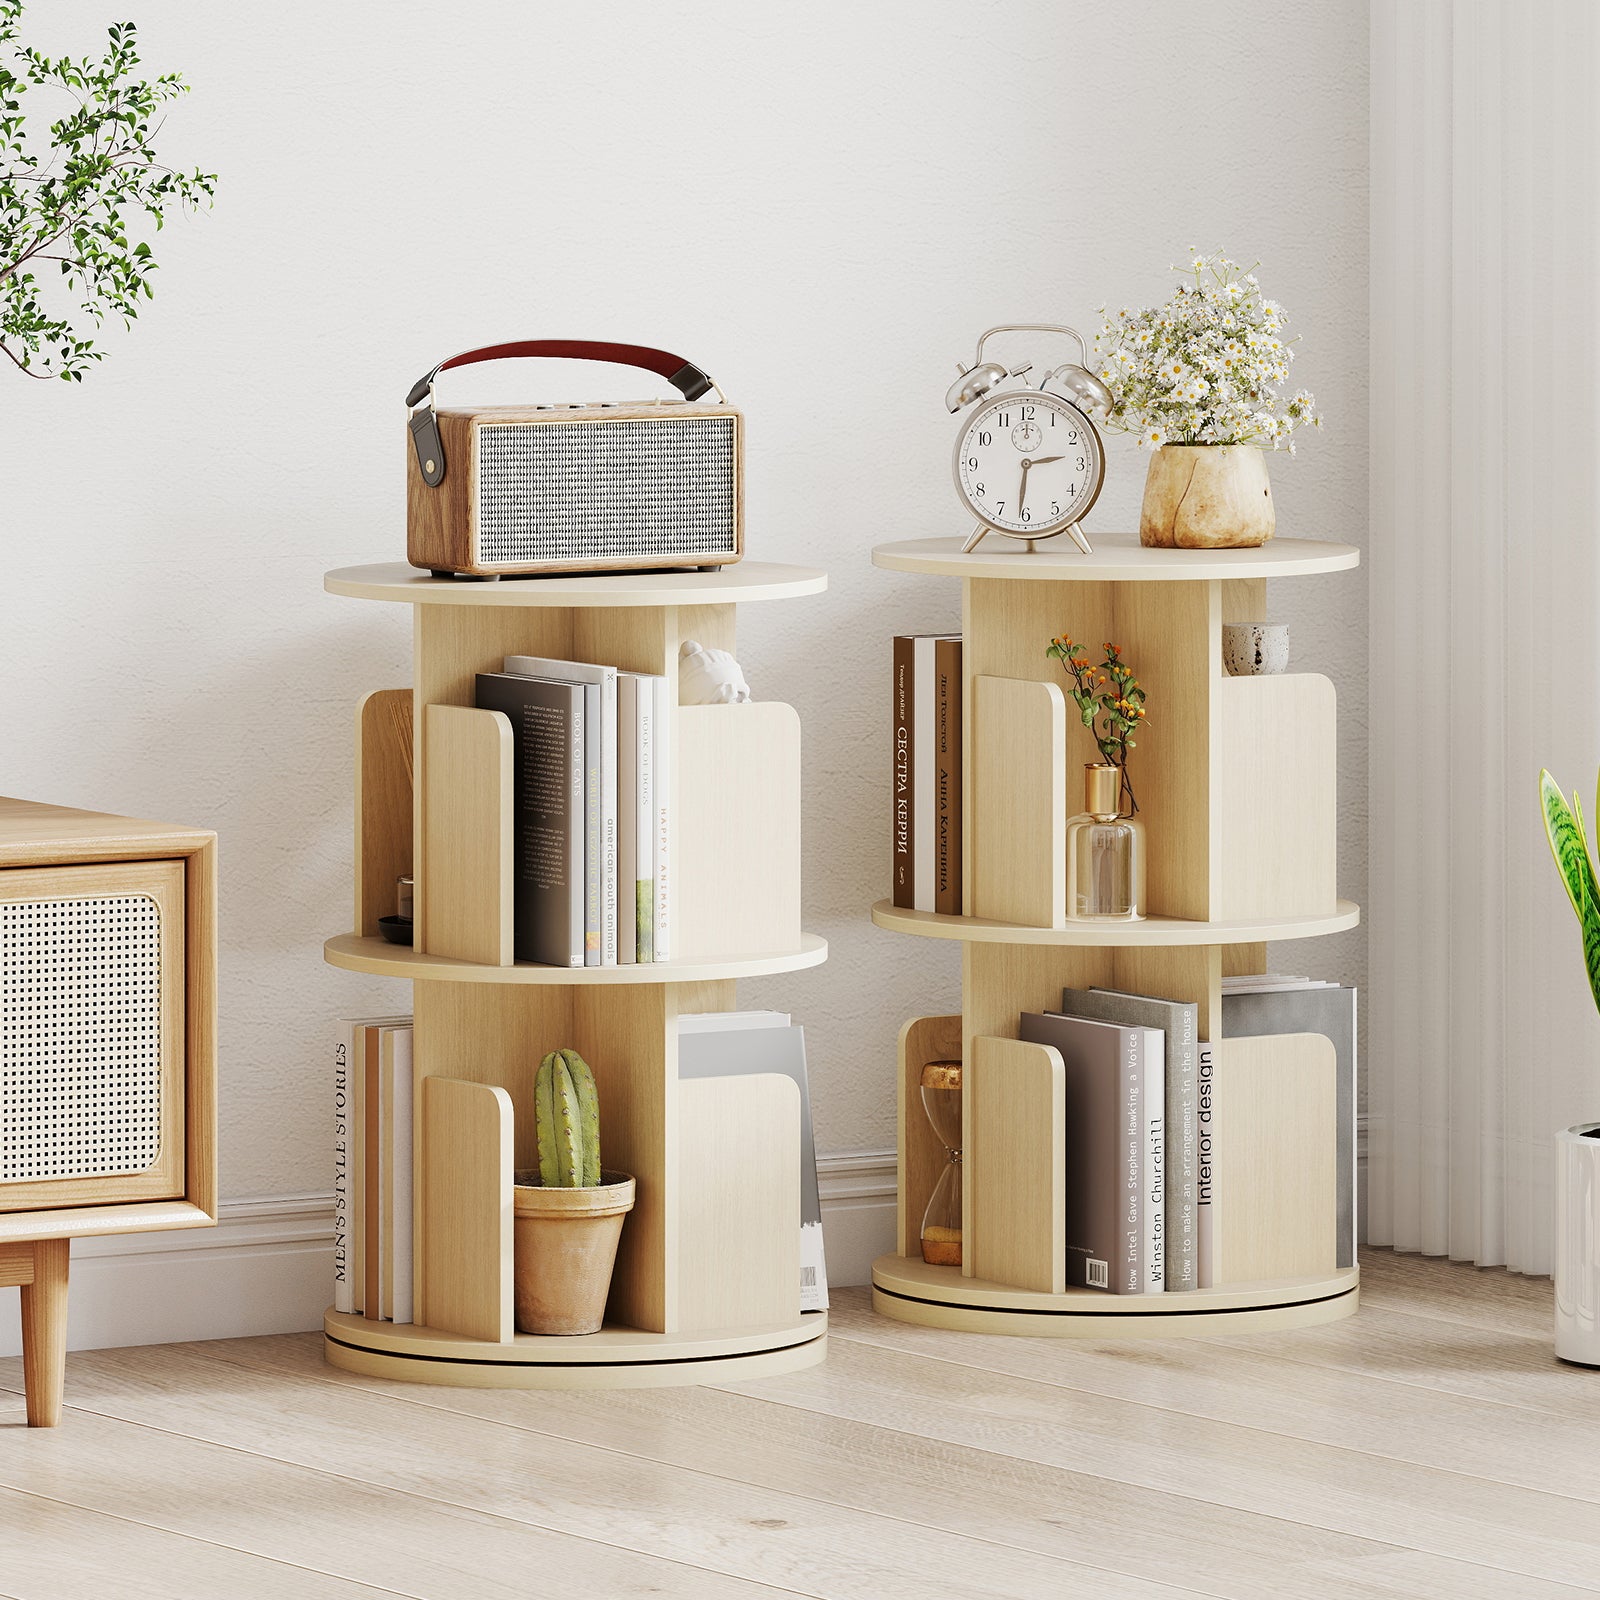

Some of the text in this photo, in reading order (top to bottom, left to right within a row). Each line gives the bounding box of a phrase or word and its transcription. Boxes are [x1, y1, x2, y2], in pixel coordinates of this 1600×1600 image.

[998, 413, 1009, 427] 11
[1021, 406, 1035, 420] 12
[1050, 413, 1056, 427] 1
[979, 432, 992, 446] 10
[1068, 431, 1077, 446] 2
[968, 457, 978, 472] 9
[1076, 457, 1085, 471] 3
[976, 482, 985, 497] 8
[1066, 483, 1076, 497] 4
[996, 501, 1005, 516] 7
[1021, 507, 1031, 522] 6
[1050, 501, 1060, 515] 5
[573, 712, 581, 797] BOOK OF CATS
[642, 753, 649, 769] OF
[589, 767, 597, 808] WORLD
[897, 727, 908, 854] СЕСТРА КЕРРИ
[589, 811, 597, 826] OF
[607, 818, 615, 960] american south animals
[589, 882, 597, 924] PARROT
[1127, 1033, 1137, 1068] Voice
[335, 1042, 346, 1136] STORIES
[1127, 1087, 1140, 1135] Hawking
[1197, 1051, 1214, 1206] Interior design
[1181, 1010, 1194, 1281] How to make an arrangement in the house
[335, 1141, 346, 1210] STYLE
[1127, 1142, 1140, 1189] Stephen
[1127, 1195, 1137, 1222] Gave
[1151, 1117, 1162, 1282] Winston Churchill
[1127, 1229, 1137, 1262] Intel
[1127, 1269, 1137, 1290] How
